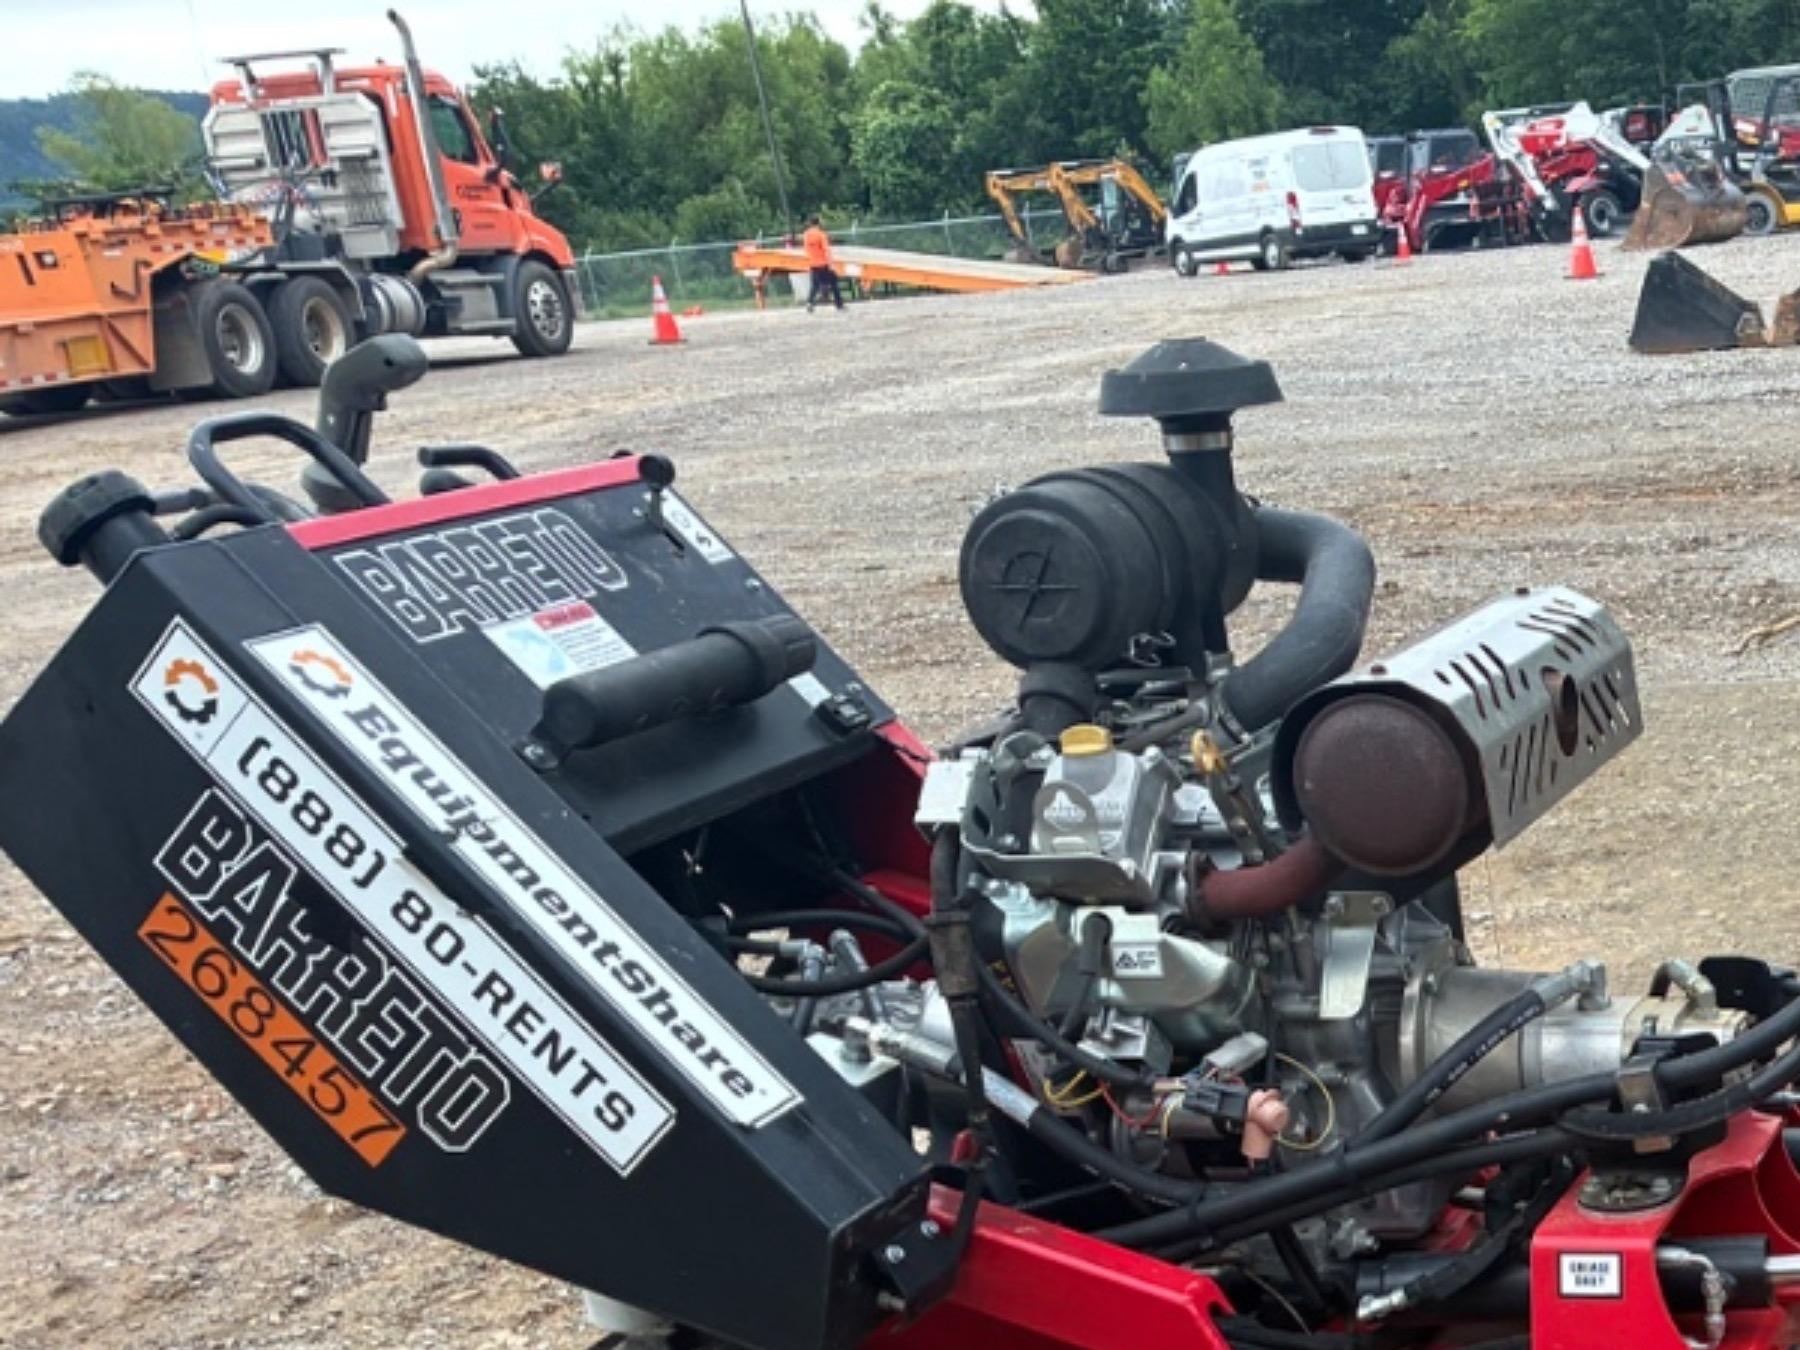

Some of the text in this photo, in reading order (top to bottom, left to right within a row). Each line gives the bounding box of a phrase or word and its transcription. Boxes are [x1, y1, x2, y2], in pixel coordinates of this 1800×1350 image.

[332, 506, 629, 644] BARRETO
[144, 904, 401, 1146] 268457
[237, 736, 636, 1132] (888) 80-RENTS
[342, 702, 754, 1099] EquipmentShare
